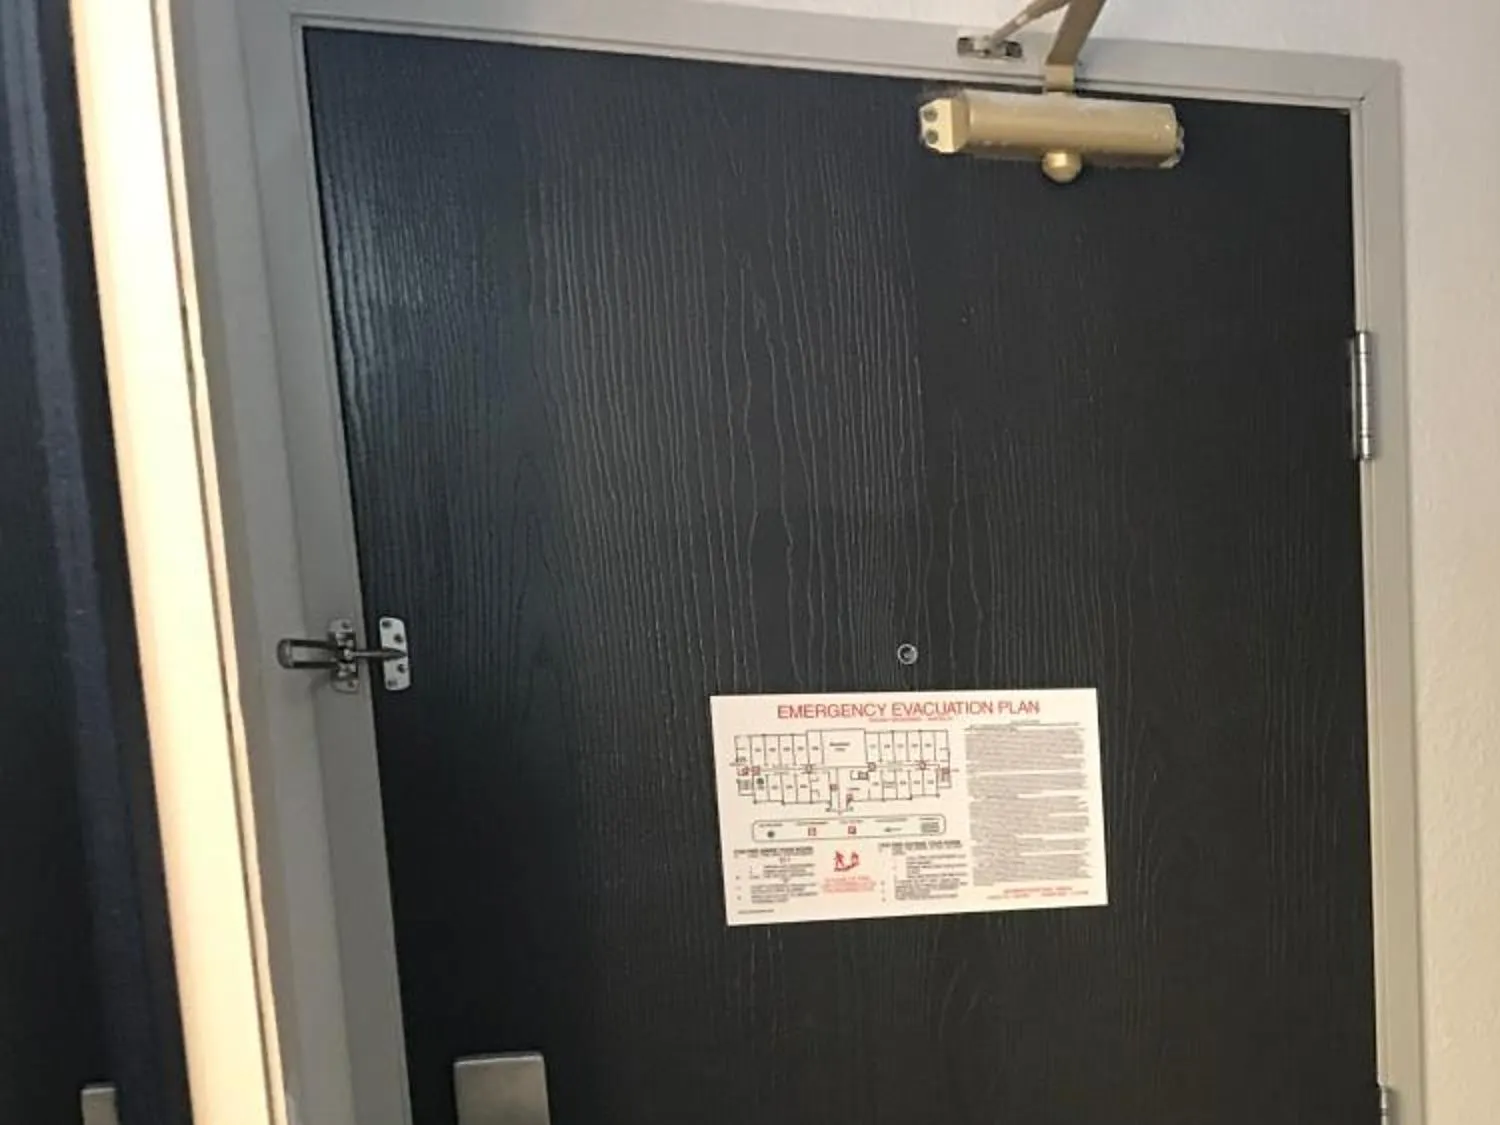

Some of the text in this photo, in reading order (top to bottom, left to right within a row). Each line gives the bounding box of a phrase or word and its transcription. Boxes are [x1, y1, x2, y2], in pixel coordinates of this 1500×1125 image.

[777, 700, 1040, 719] EMERGENCY EVACUATION PLAN
